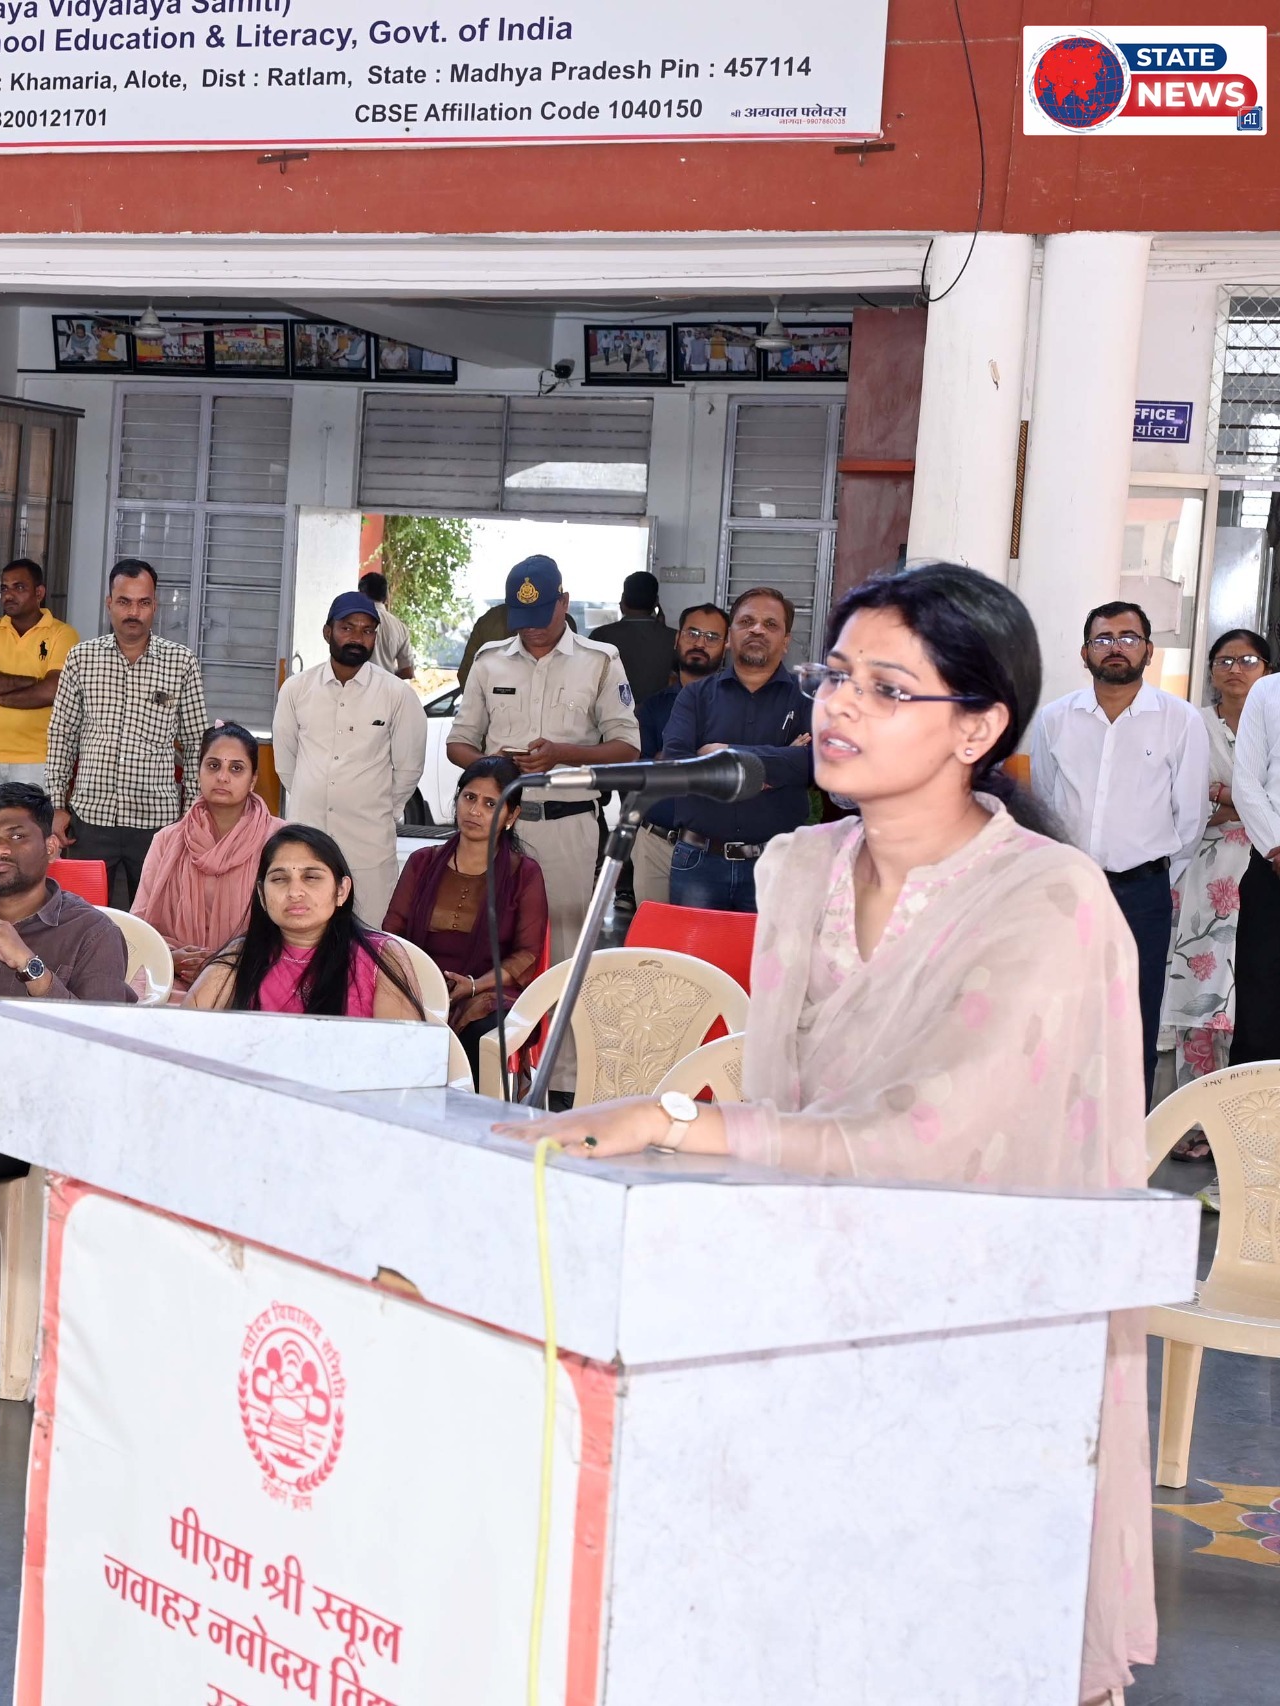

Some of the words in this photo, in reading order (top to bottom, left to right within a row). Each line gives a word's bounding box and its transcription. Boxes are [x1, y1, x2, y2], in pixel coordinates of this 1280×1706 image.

[49, 0, 181, 22] Vidyalaya
[55, 27, 195, 51] Education
[205, 25, 225, 48] &
[236, 24, 358, 51] Literacy,
[369, 20, 447, 44] Govt.
[458, 18, 490, 42] of
[498, 16, 572, 41] India
[10, 71, 117, 92] Khamaria,
[124, 70, 187, 92] Alote,
[202, 69, 246, 88] Dist
[268, 67, 352, 88] Ratlam,
[367, 65, 427, 84] State
[450, 63, 542, 86] Madhya
[551, 60, 651, 81] Pradesh
[660, 59, 700, 79] Pin
[723, 57, 812, 78] 457114
[355, 104, 418, 122] CBSE
[423, 103, 532, 122] Affillation
[540, 101, 600, 121] Code
[608, 98, 703, 119] 1040150
[744, 107, 798, 118] अग्रवाल
[1134, 408, 1176, 421] FFICE
[170, 1507, 253, 1591] पीएम
[261, 1555, 305, 1616] श्री
[313, 1585, 403, 1668] स्कूल
[104, 1553, 201, 1638] जवाहर
[208, 1609, 321, 1701] नवोदय
